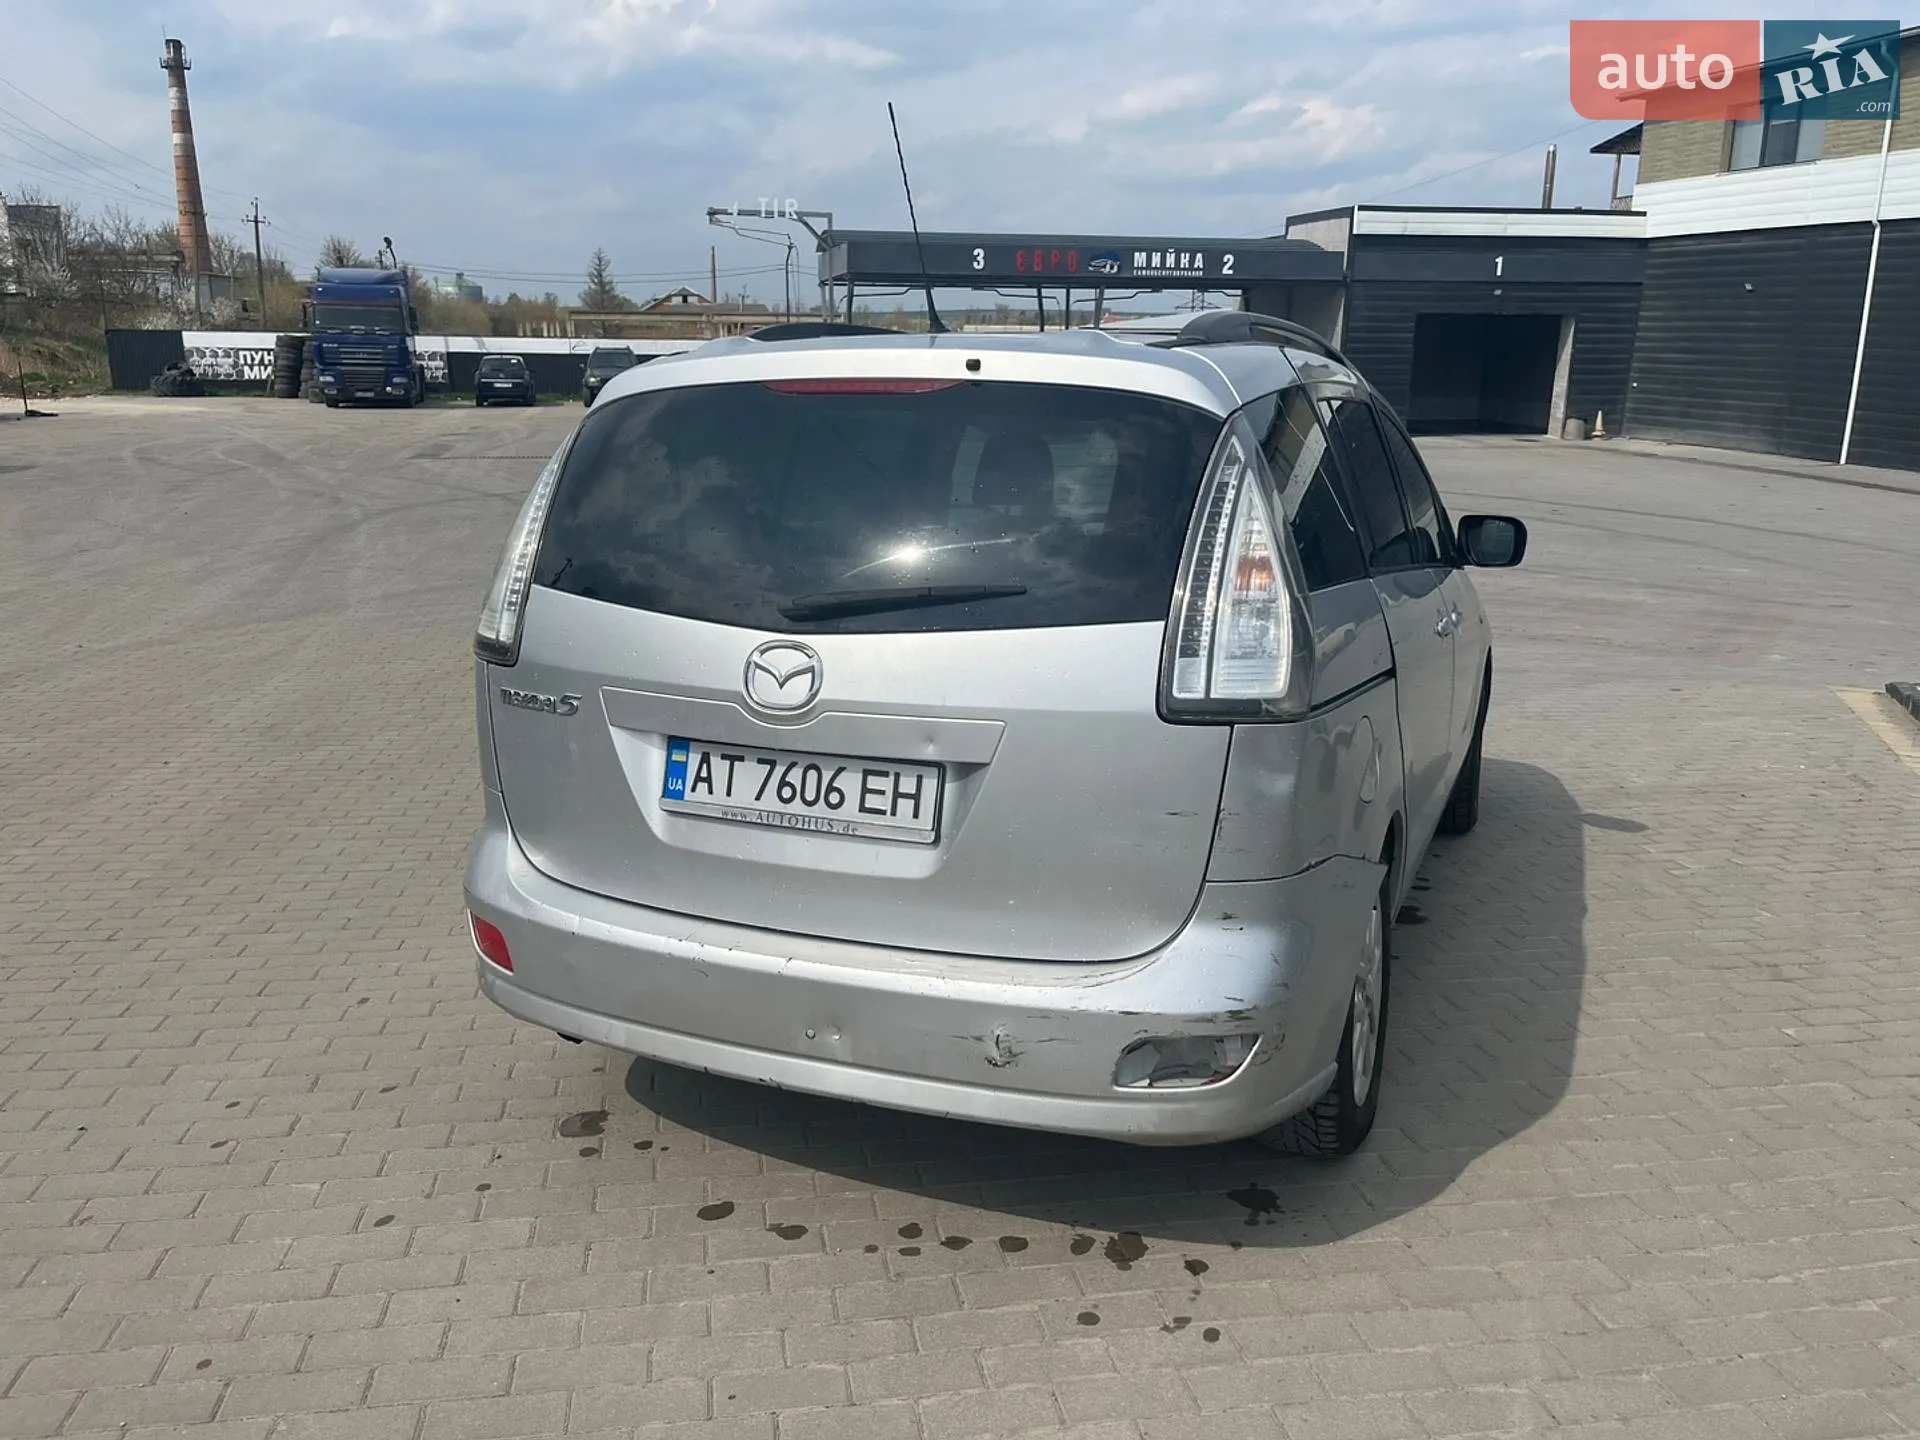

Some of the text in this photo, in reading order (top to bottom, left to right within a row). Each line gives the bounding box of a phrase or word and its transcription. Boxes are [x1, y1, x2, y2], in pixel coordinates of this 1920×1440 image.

[758, 197, 798, 219] TIR
[973, 248, 985, 270] 3
[1133, 248, 1204, 269] МИЙКА
[1222, 254, 1235, 275] 2
[1495, 256, 1503, 276] 1
[668, 777, 684, 792] UA
[690, 751, 924, 820] AT 7606 EH
